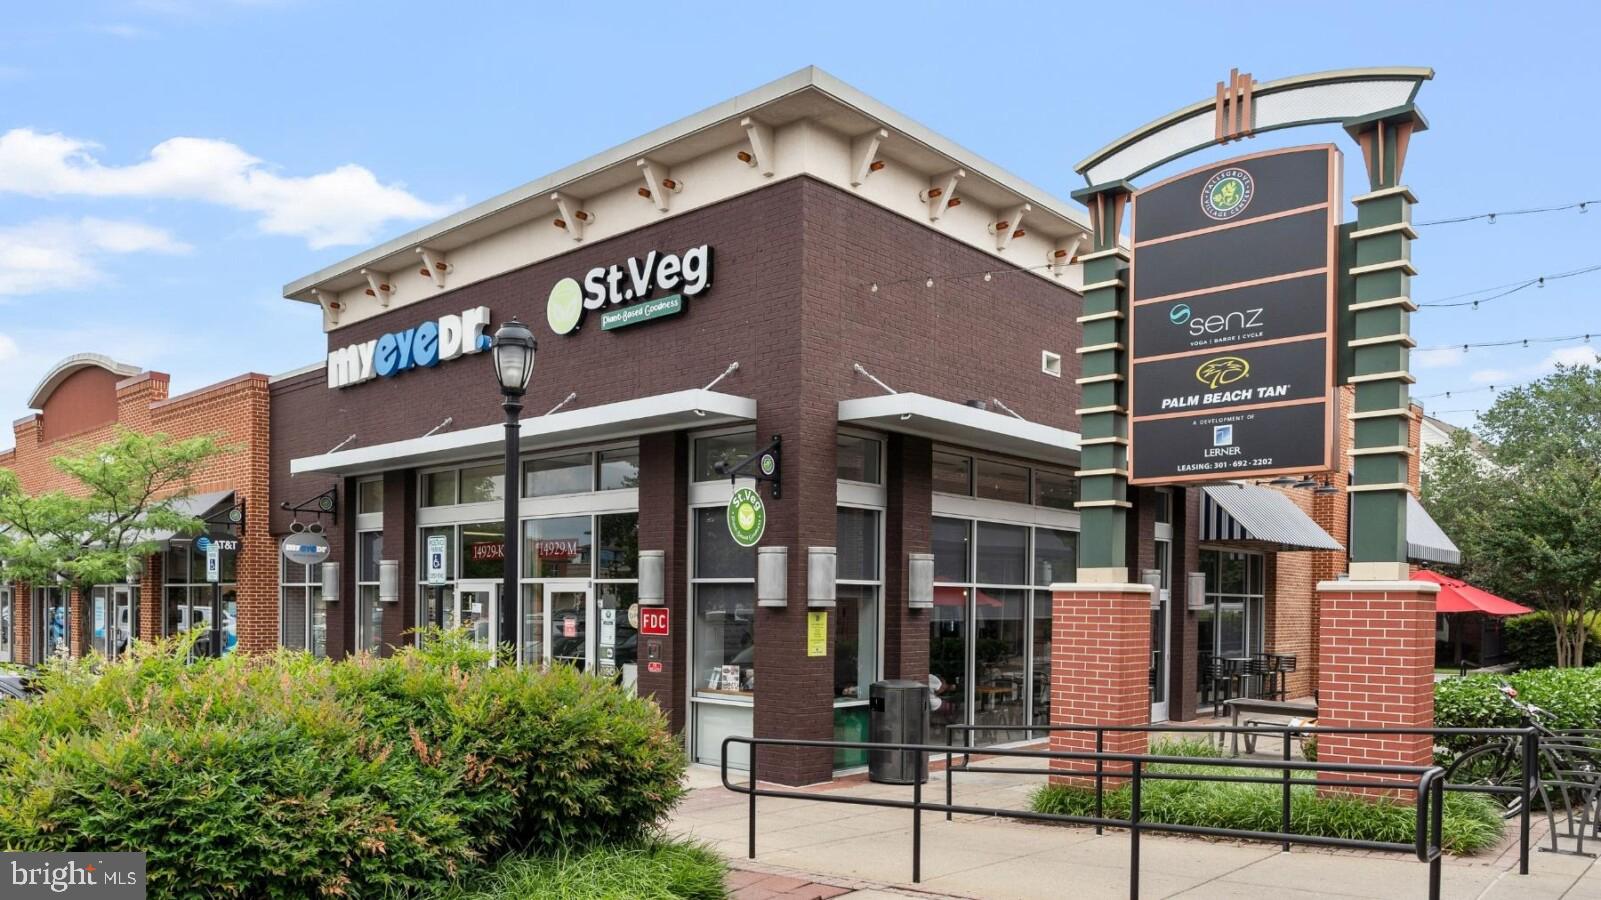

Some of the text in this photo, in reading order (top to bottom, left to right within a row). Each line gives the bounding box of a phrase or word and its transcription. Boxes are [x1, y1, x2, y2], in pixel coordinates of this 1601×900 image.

[583, 244, 709, 310] St.Veg
[644, 299, 679, 316] Goodness
[1189, 308, 1264, 336] senz
[1214, 335, 1236, 343] BARRE
[1242, 331, 1264, 339] CYCLE
[1161, 395, 1200, 409] PALM
[1203, 389, 1253, 404] BEACH
[1199, 415, 1244, 425] DEVELOPMENT
[1204, 446, 1242, 458] LERNER
[1177, 462, 1213, 472] LEASING:
[473, 544, 504, 559] 14929-K
[643, 614, 666, 629] FDC
